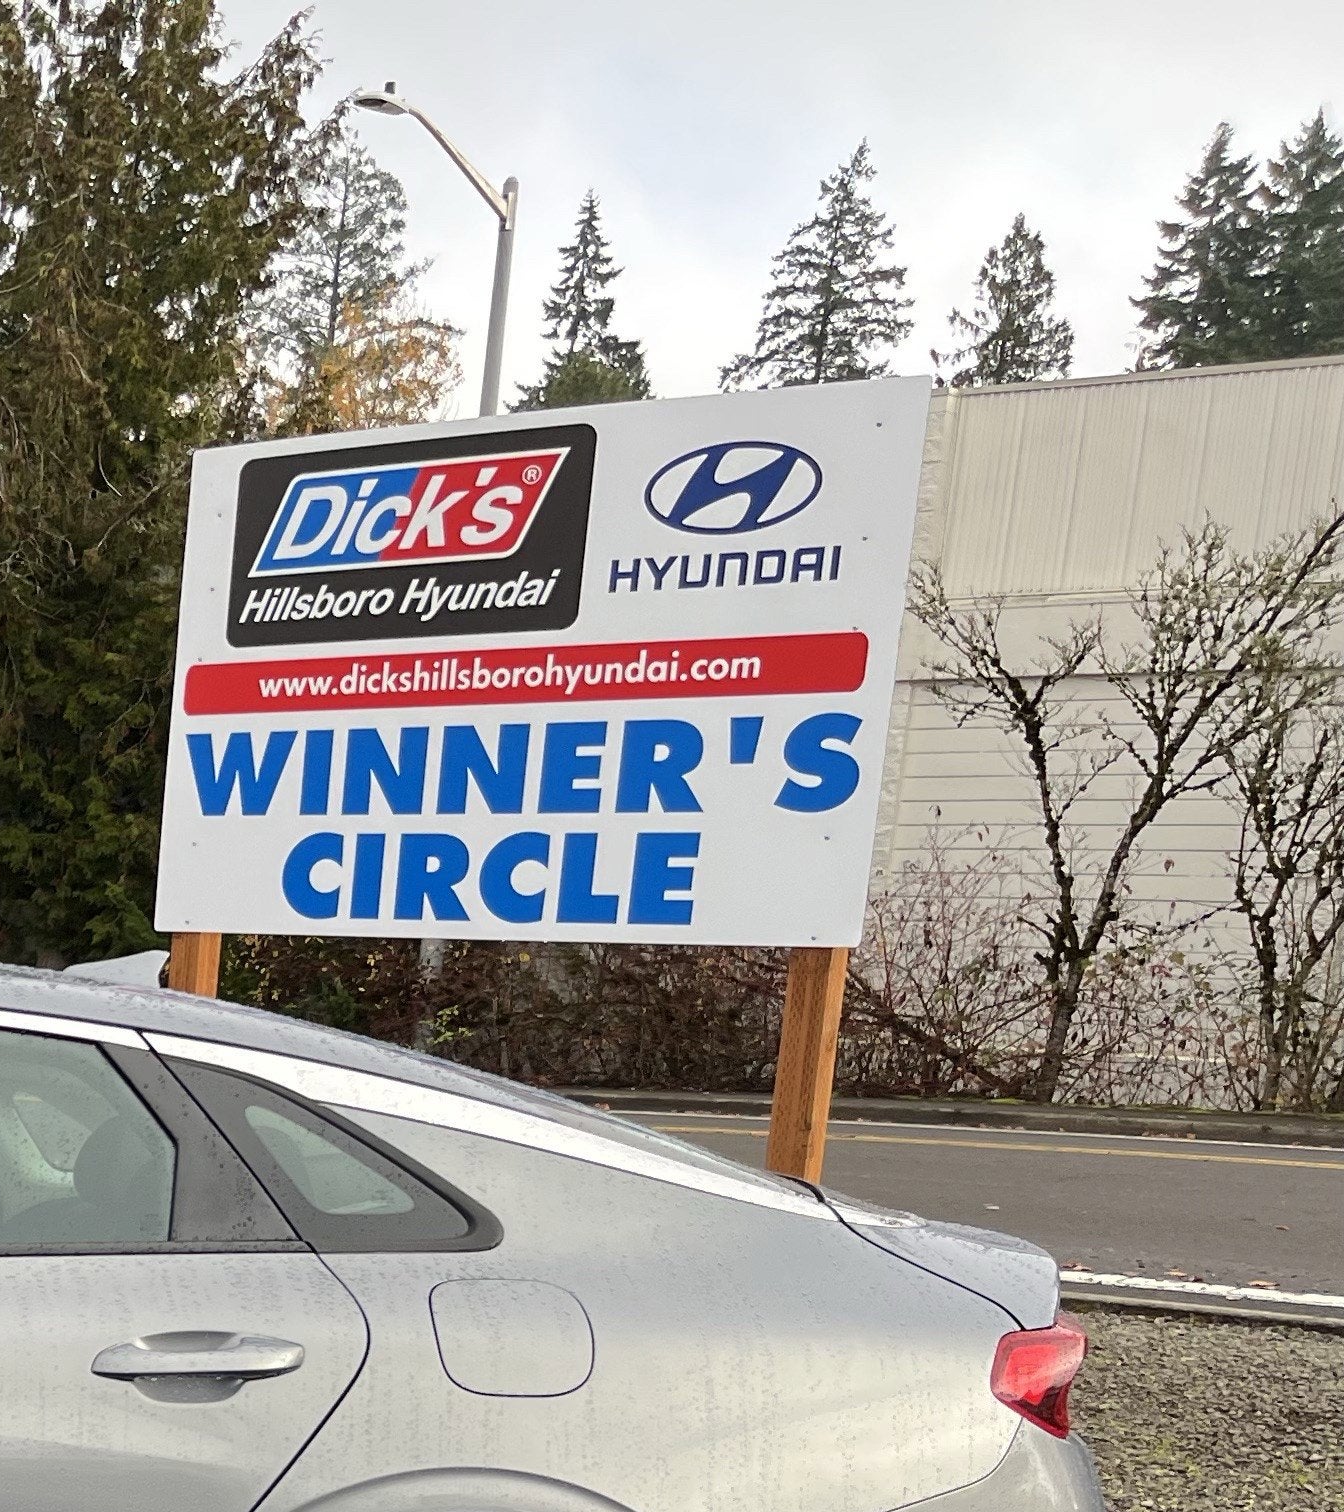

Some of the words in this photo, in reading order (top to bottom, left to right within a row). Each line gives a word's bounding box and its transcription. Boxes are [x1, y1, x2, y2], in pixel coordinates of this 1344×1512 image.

[238, 584, 395, 624] Hillsboro
[398, 569, 562, 621] Hyundai
[608, 545, 842, 593] HYUNDAI
[258, 653, 762, 698] www.dickshillsborohyundai.com
[186, 712, 864, 817] WINNER'S
[282, 832, 702, 926] CIRCLE
